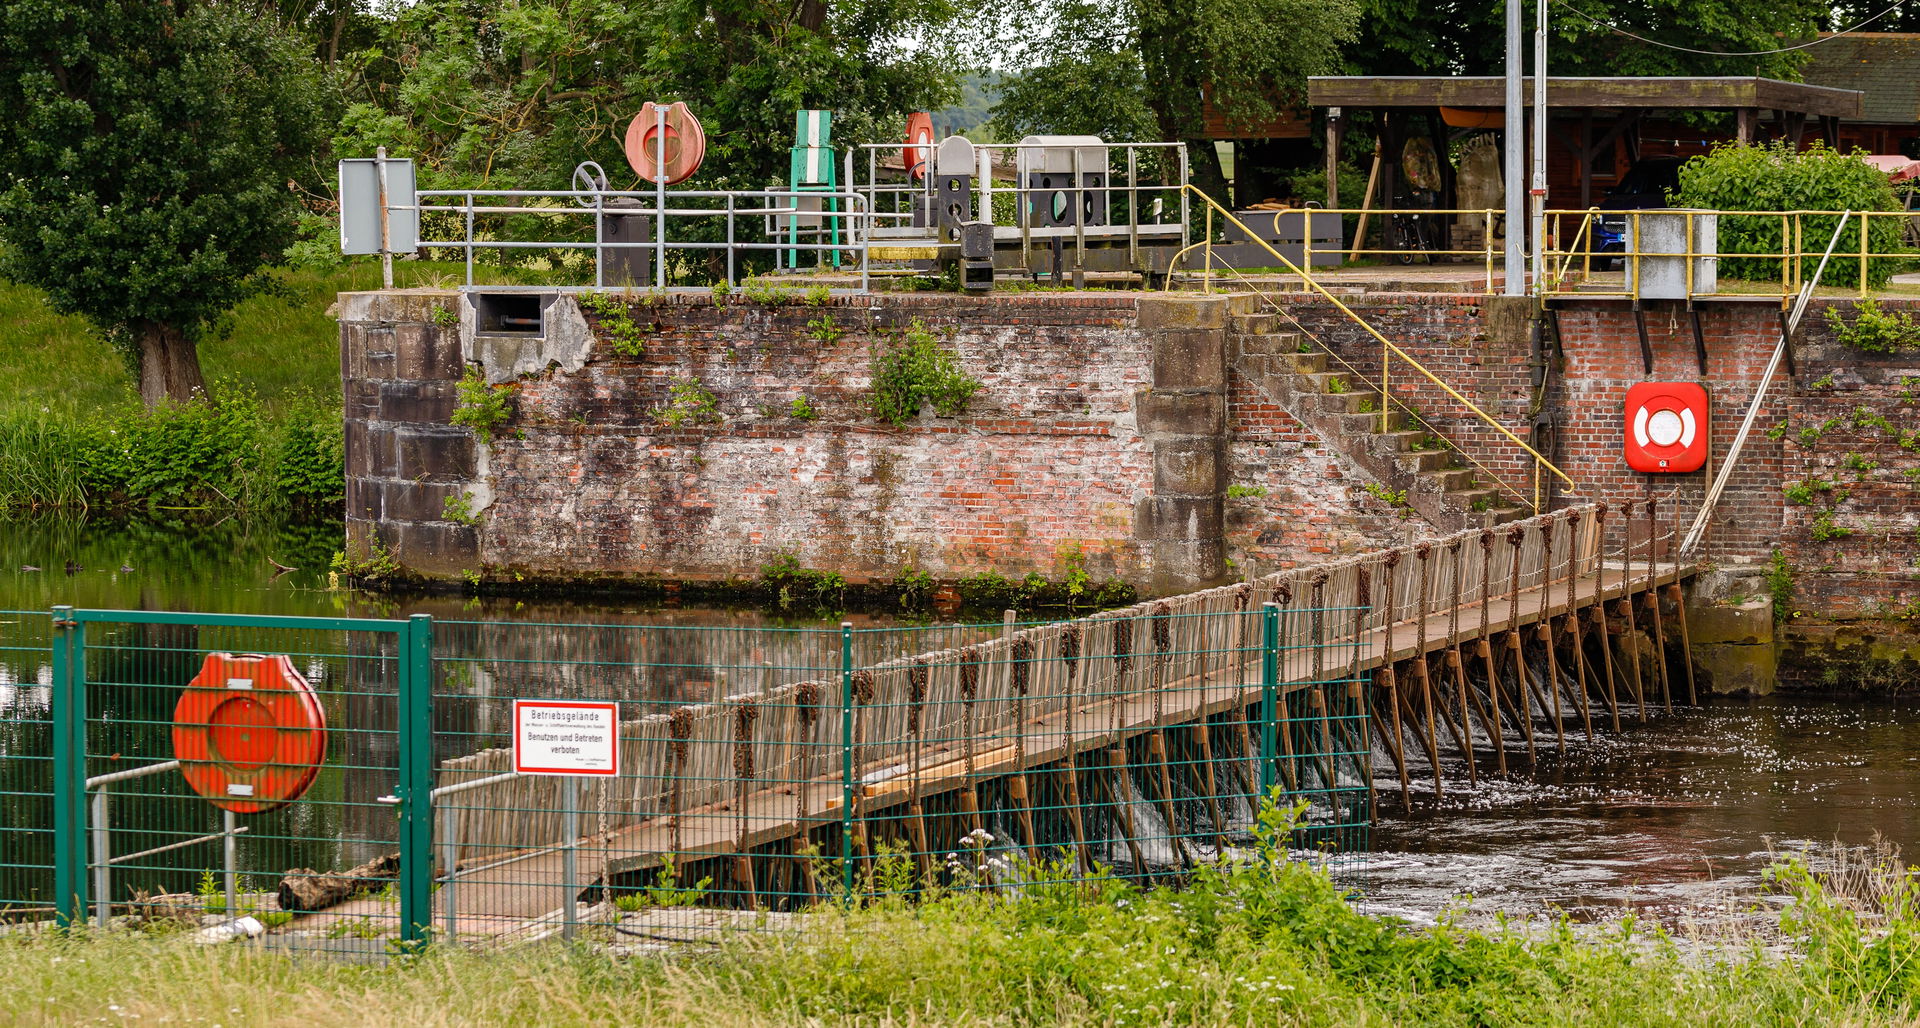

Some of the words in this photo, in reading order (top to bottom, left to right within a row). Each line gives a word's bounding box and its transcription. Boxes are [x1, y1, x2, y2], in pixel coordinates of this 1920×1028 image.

[531, 710, 599, 722] Betriebsgelände
[528, 732, 558, 741] Benutzen
[560, 733, 572, 742] und
[575, 733, 602, 743] Betreten
[551, 745, 580, 754] verboten
